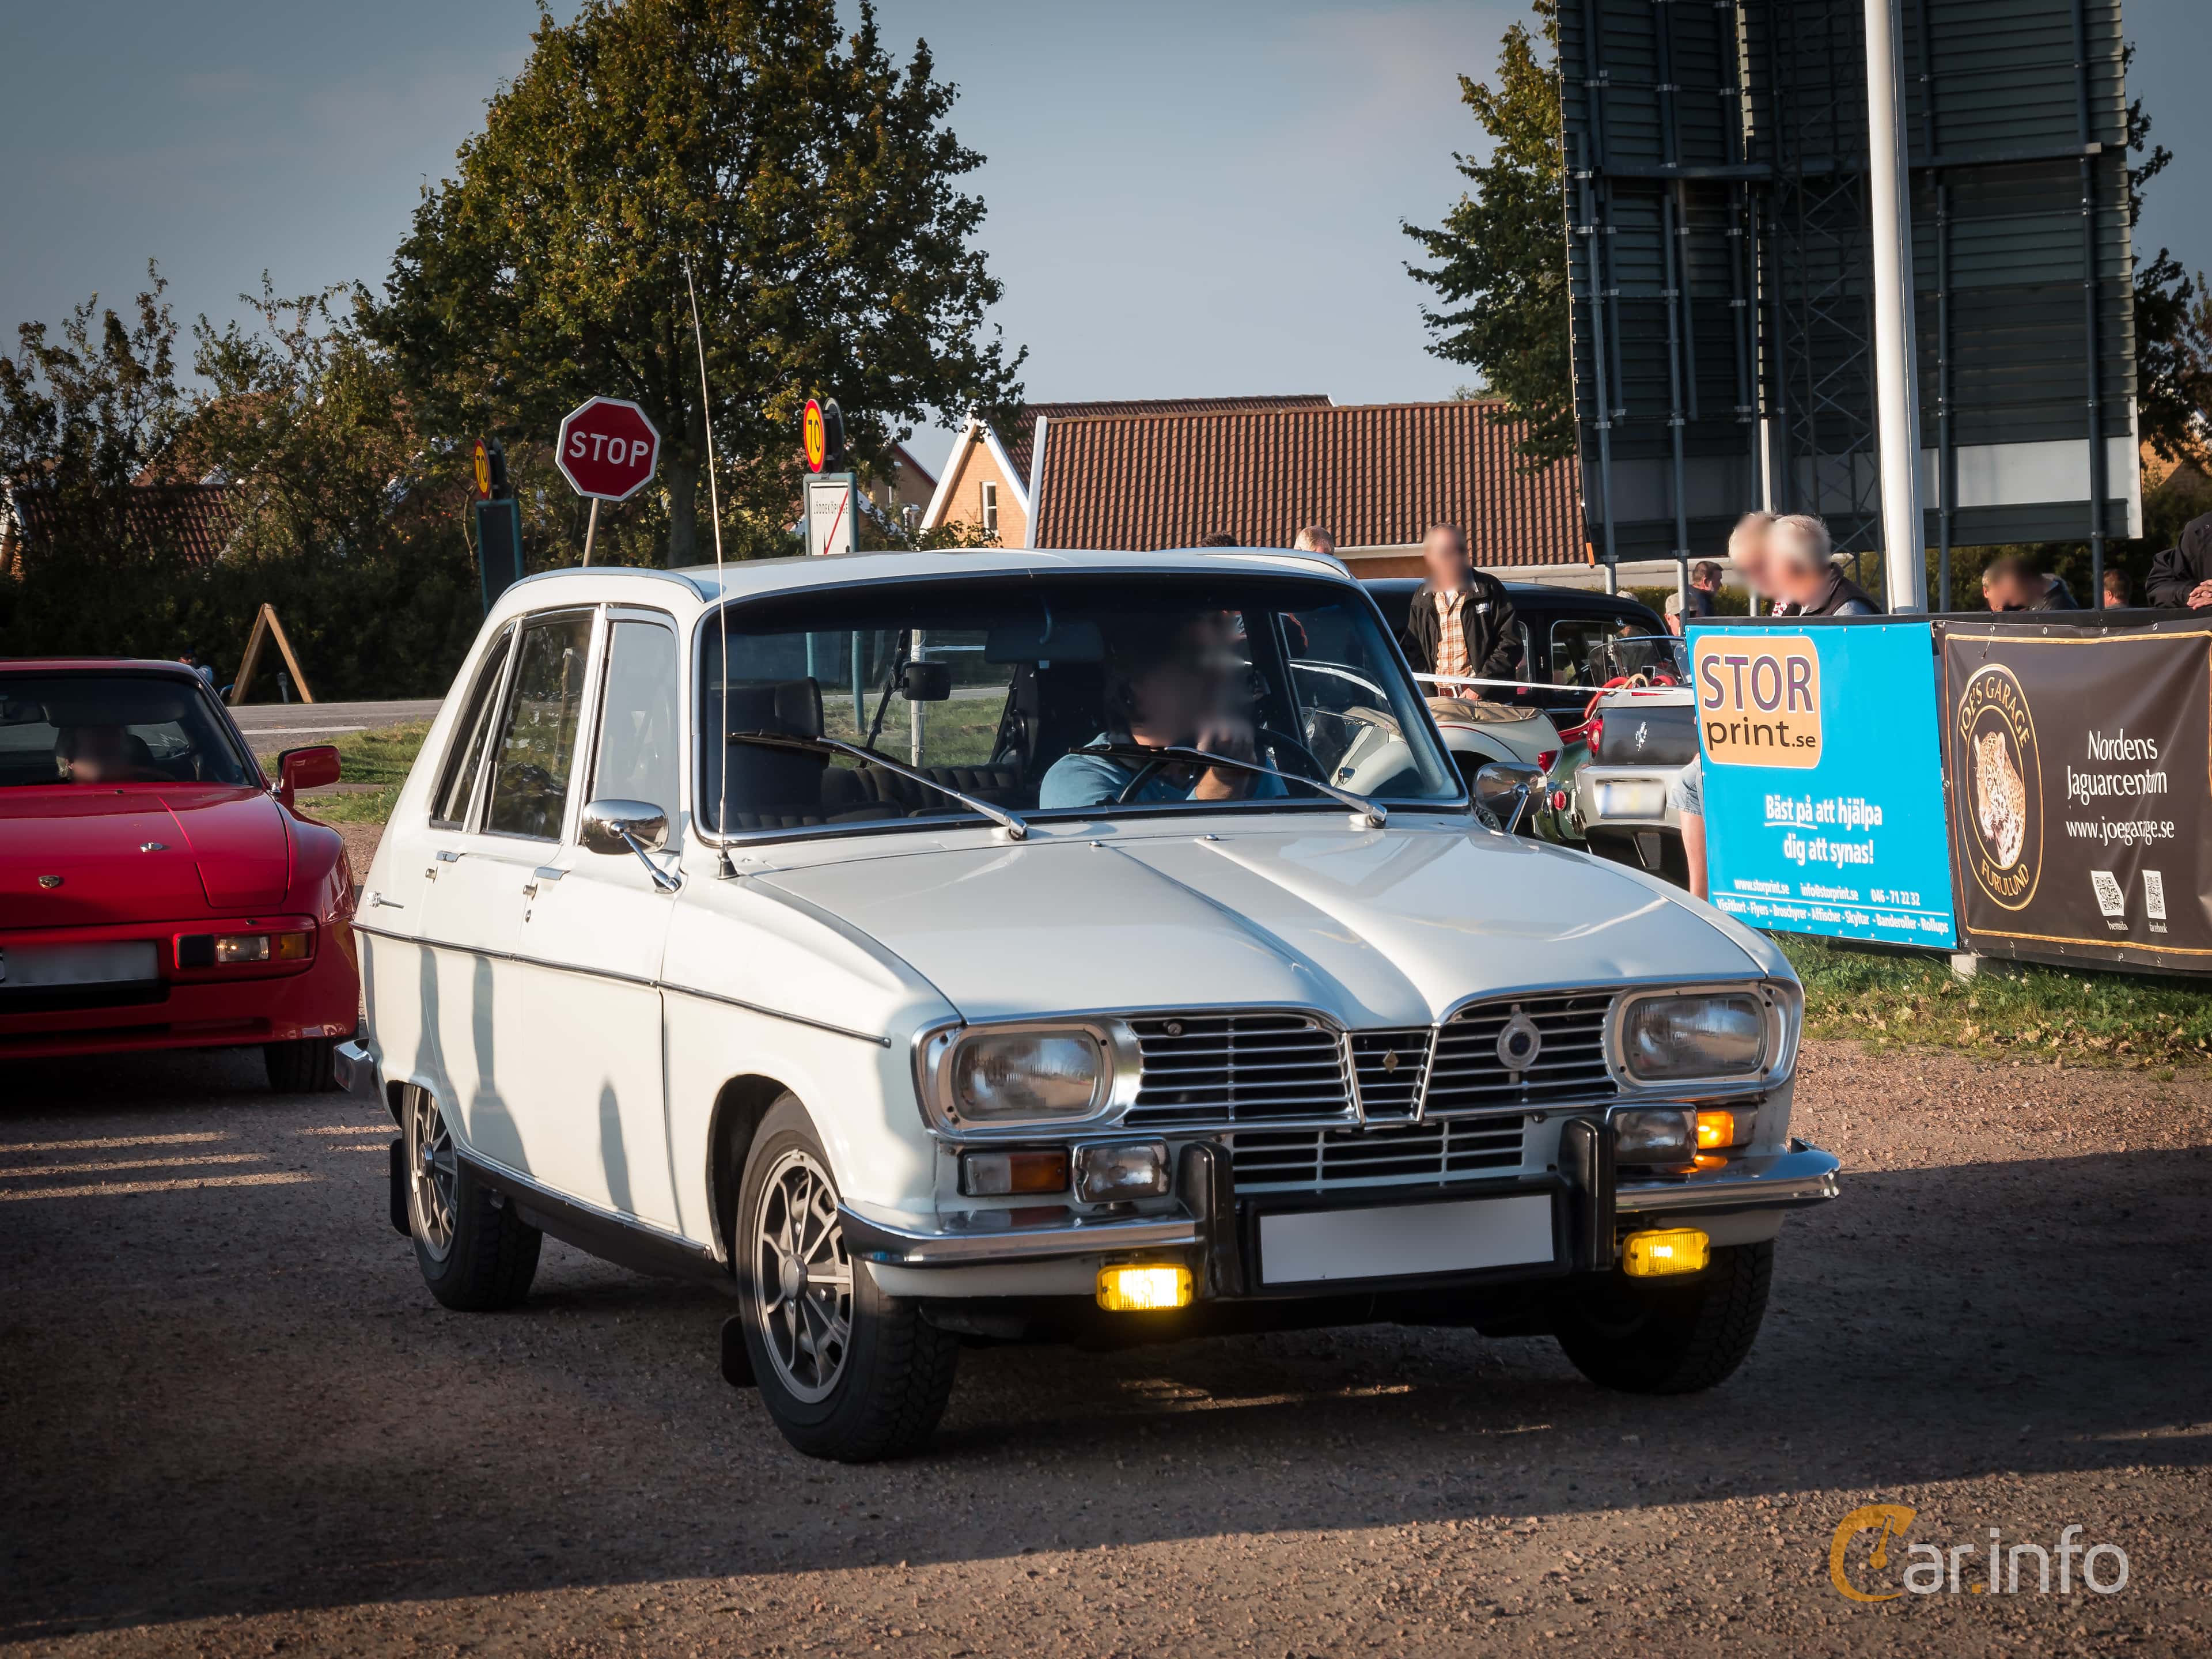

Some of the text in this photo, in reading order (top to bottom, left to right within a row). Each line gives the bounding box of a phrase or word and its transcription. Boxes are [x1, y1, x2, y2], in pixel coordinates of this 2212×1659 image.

[569, 431, 649, 467] STOP
[808, 419, 820, 453] 70
[476, 454, 487, 484] 70
[1701, 653, 1815, 713] STOR
[1960, 676, 2030, 748] JOE'S GARAGE
[1707, 717, 1816, 751] print.se
[2088, 728, 2158, 760] Nordens
[2067, 766, 2167, 805] Jaguarcentum
[1766, 794, 1883, 831] Bäst på att hjälpa
[1783, 833, 1874, 869] dig att synas!
[1734, 879, 1790, 895] www.storprint.se
[1800, 882, 1859, 902] info@storprint.se
[1870, 888, 1885, 903] 046
[1889, 889, 1899, 904] 71
[1900, 890, 1910, 905] 22
[1910, 891, 1921, 906] 32
[1982, 858, 2029, 896] FURULUND
[1716, 899, 1747, 913] Visitkort
[1749, 901, 1769, 918] Flyers
[1772, 904, 1806, 922] Broschyrer
[1811, 907, 1841, 922] Affischer
[1844, 910, 1869, 927] Skyltar
[1875, 913, 1916, 930] Banderoller
[1920, 917, 1949, 935] Rollups
[2149, 921, 2168, 933] facebook
